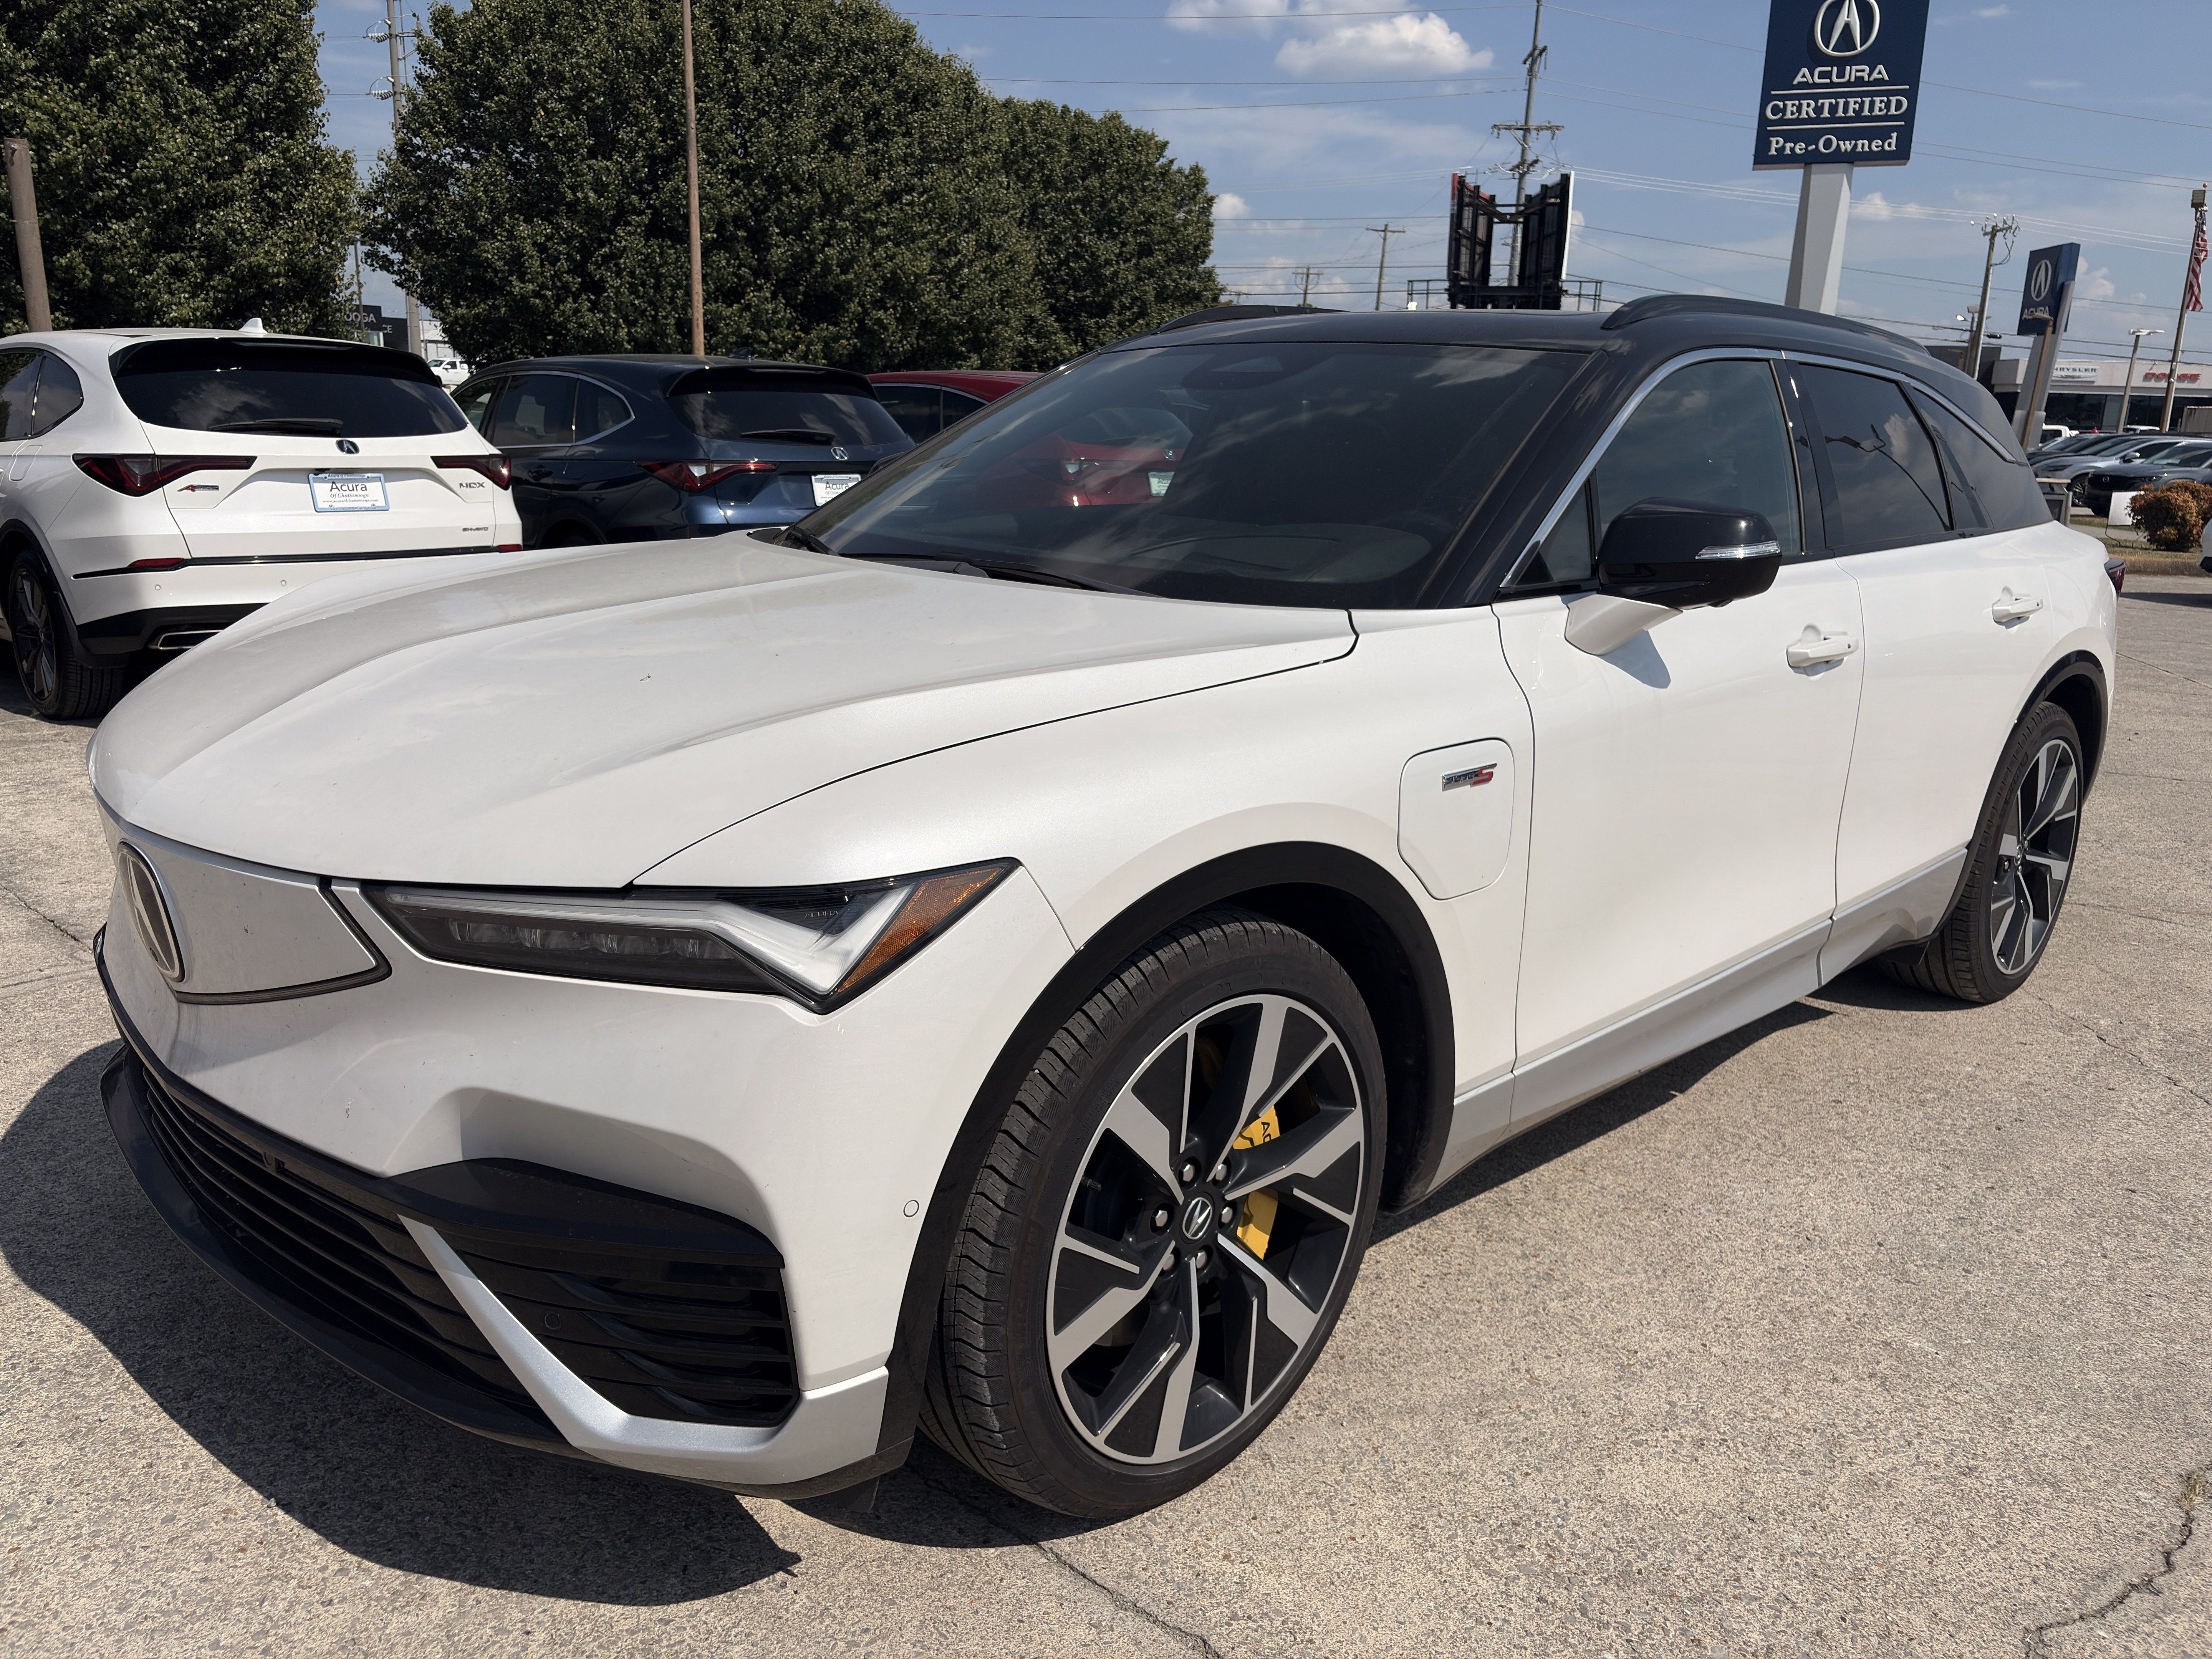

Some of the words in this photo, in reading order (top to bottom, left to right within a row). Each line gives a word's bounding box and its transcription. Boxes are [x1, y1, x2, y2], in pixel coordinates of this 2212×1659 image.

[1792, 65, 1889, 85] ACURA
[1765, 96, 1908, 120] CERTIFIED
[1768, 132, 1897, 155] Pre-Owned
[2146, 372, 2201, 381] DOGE
[330, 481, 368, 492] Acura
[825, 481, 849, 490] Acura
